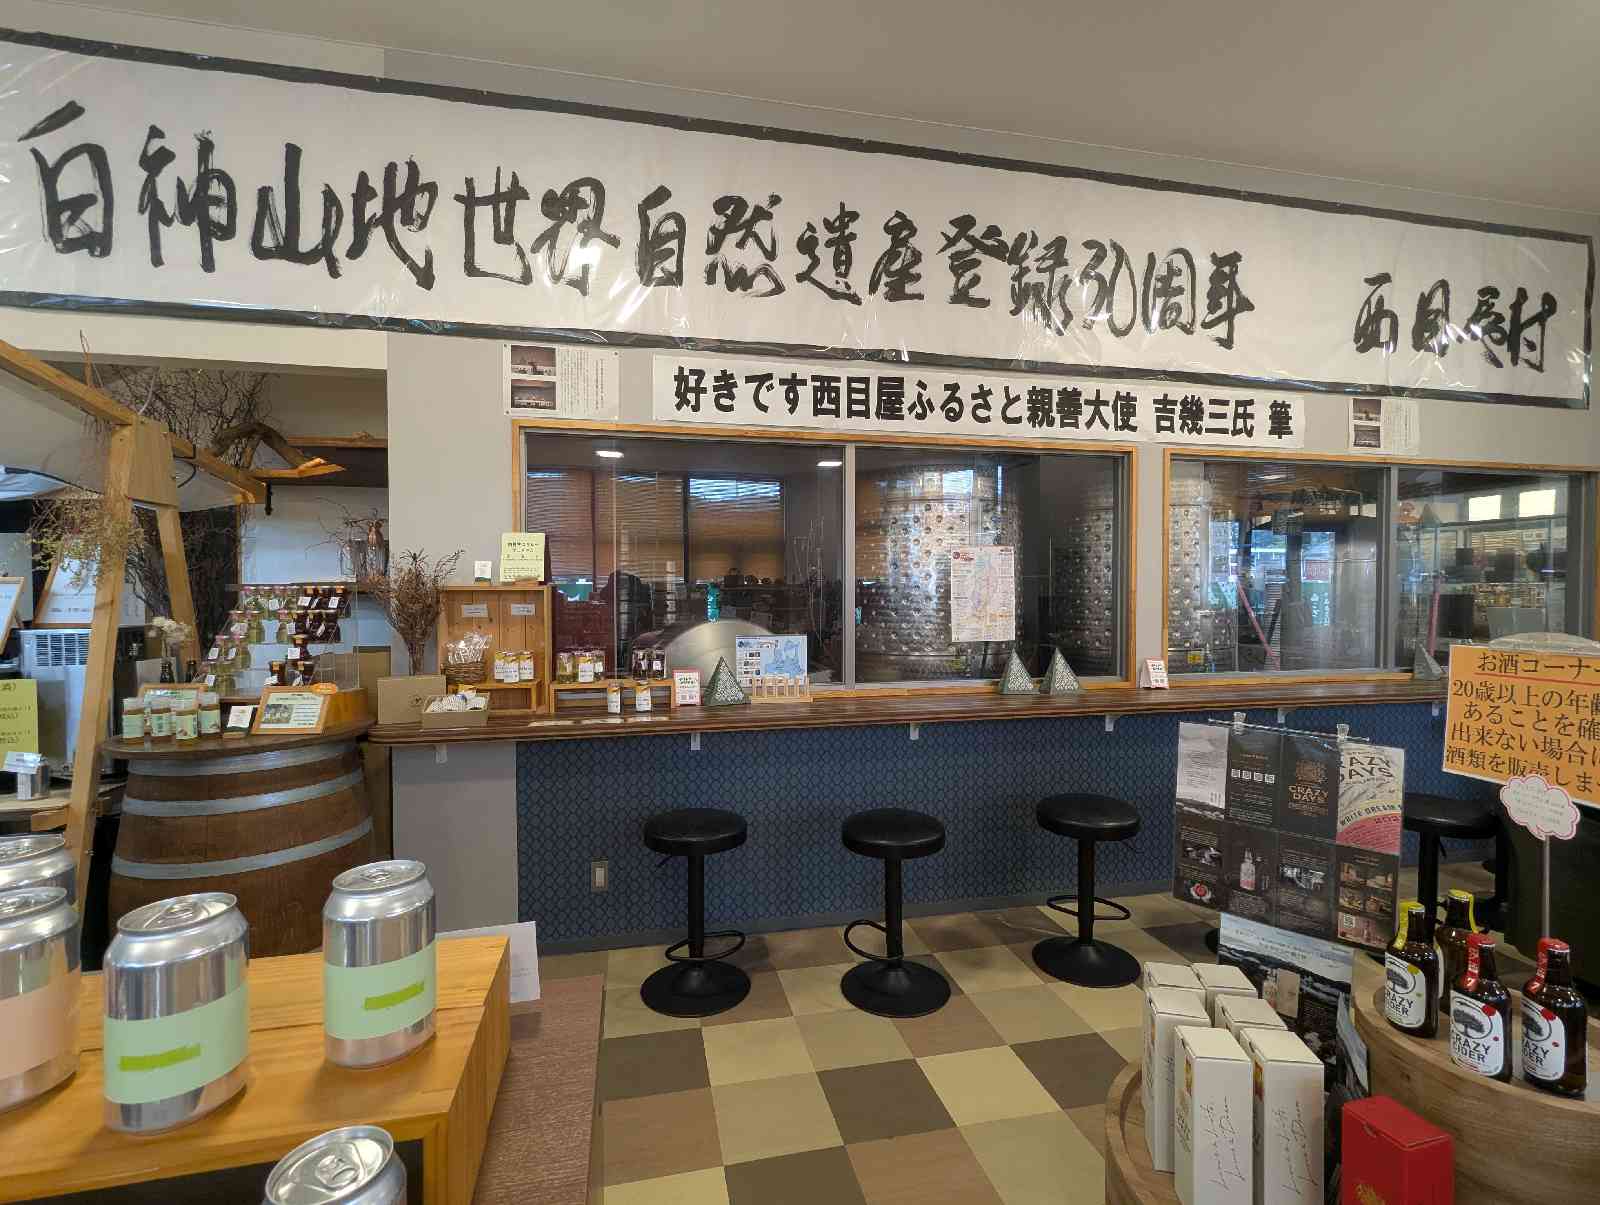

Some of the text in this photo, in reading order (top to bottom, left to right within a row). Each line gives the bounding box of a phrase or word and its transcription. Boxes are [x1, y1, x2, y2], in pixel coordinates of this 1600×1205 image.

[673, 365, 1293, 440] 好きです西目屋ふるさと親善大使 吉幾三氏 筆
[1446, 744, 1600, 794] 酒類を販売しま
[1386, 990, 1413, 1009] RAZY
[1455, 1032, 1491, 1055] RAZY
[1456, 1043, 1486, 1063] IDER
